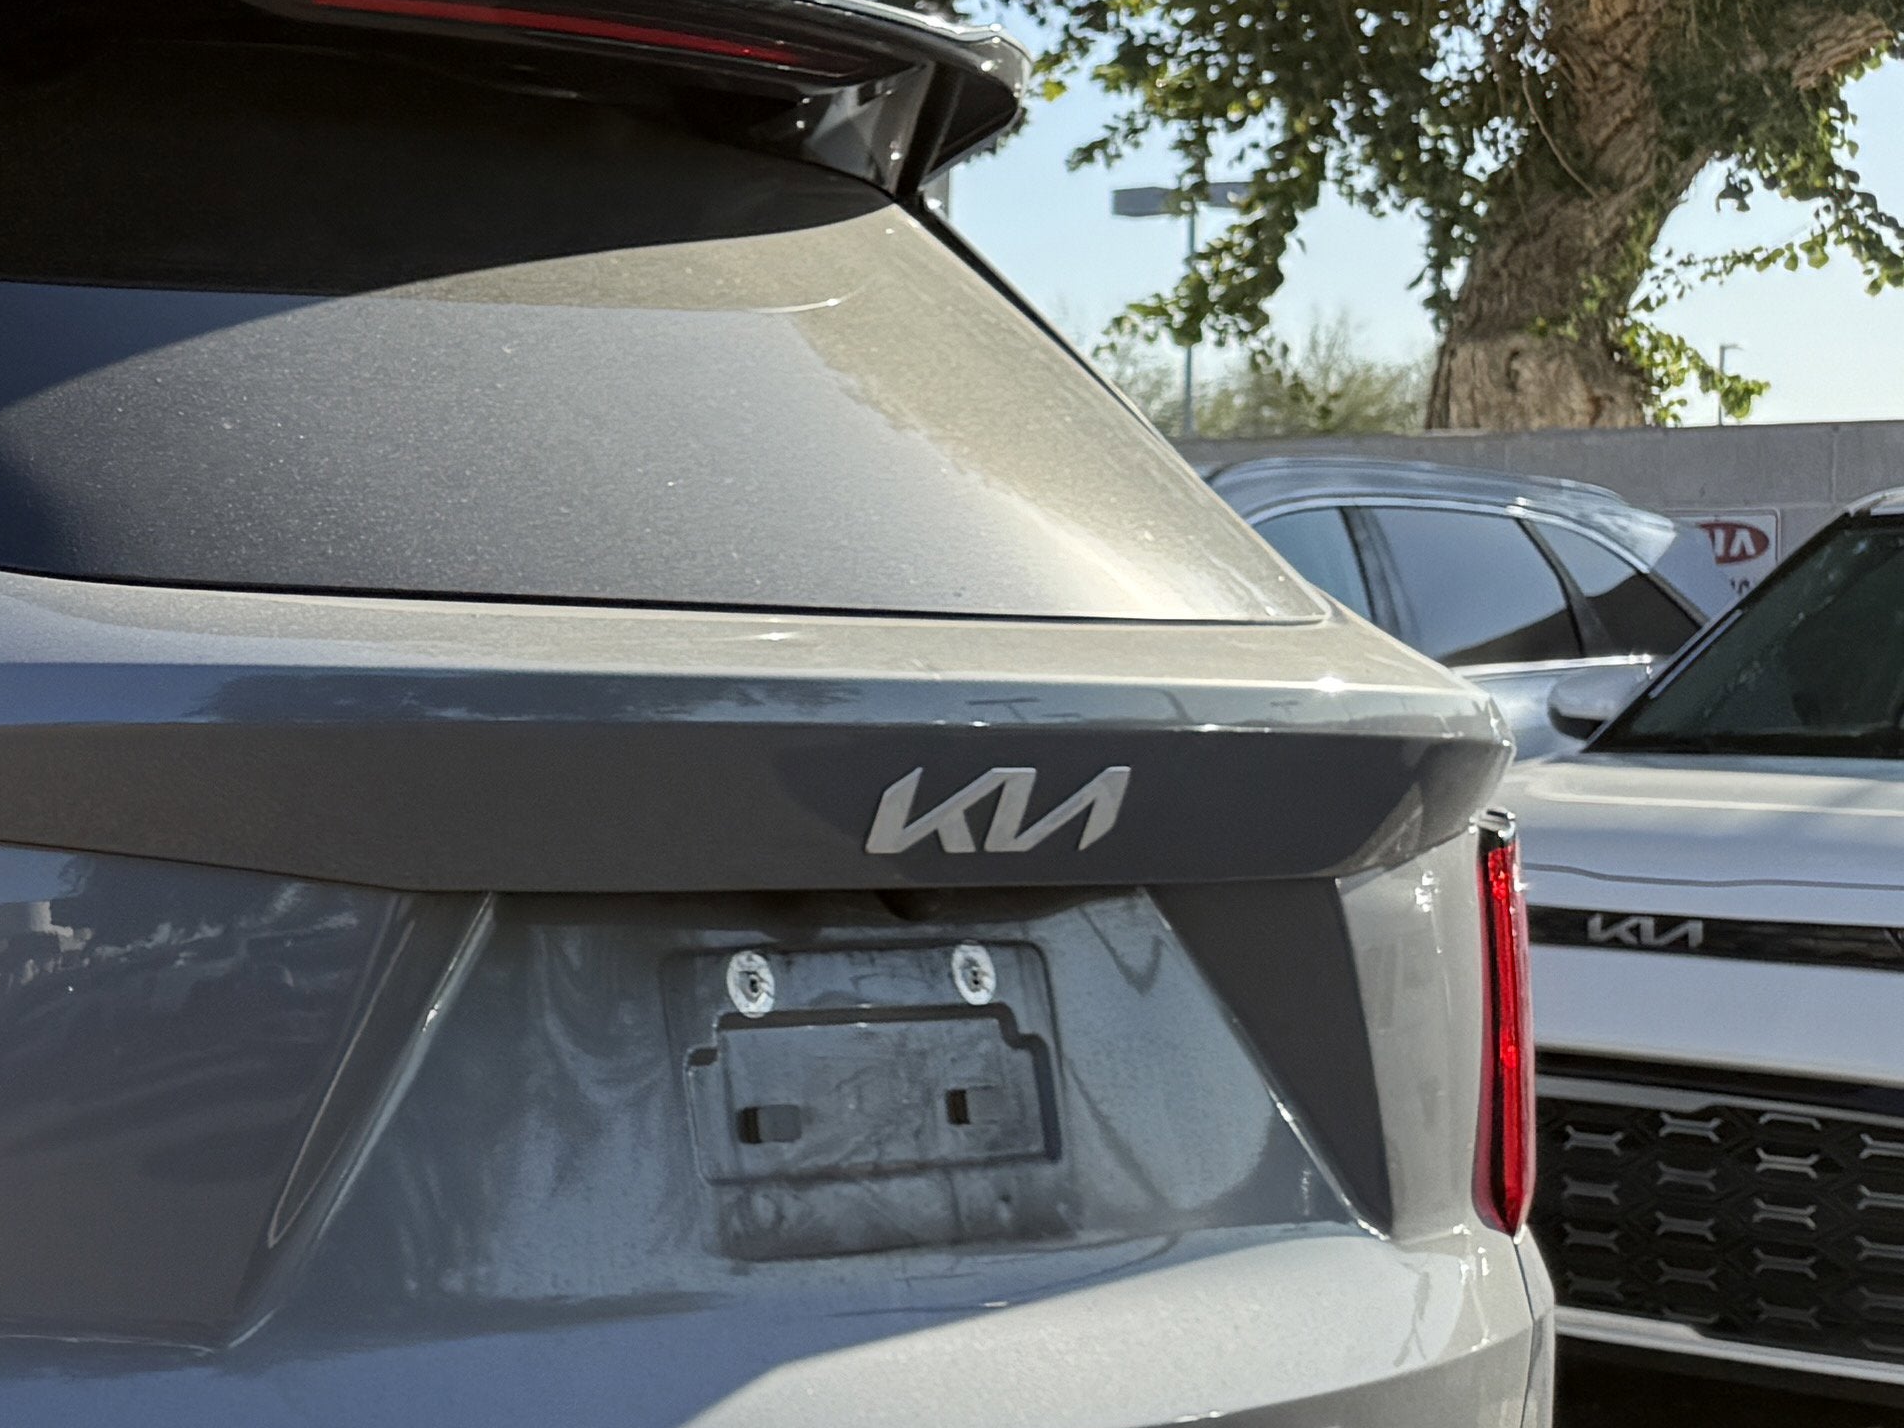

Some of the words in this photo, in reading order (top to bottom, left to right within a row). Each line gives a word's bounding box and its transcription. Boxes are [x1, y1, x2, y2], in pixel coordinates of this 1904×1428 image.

[1713, 528, 1757, 557] IA
[864, 765, 1132, 854] KIA
[1586, 912, 1704, 949] KIA
